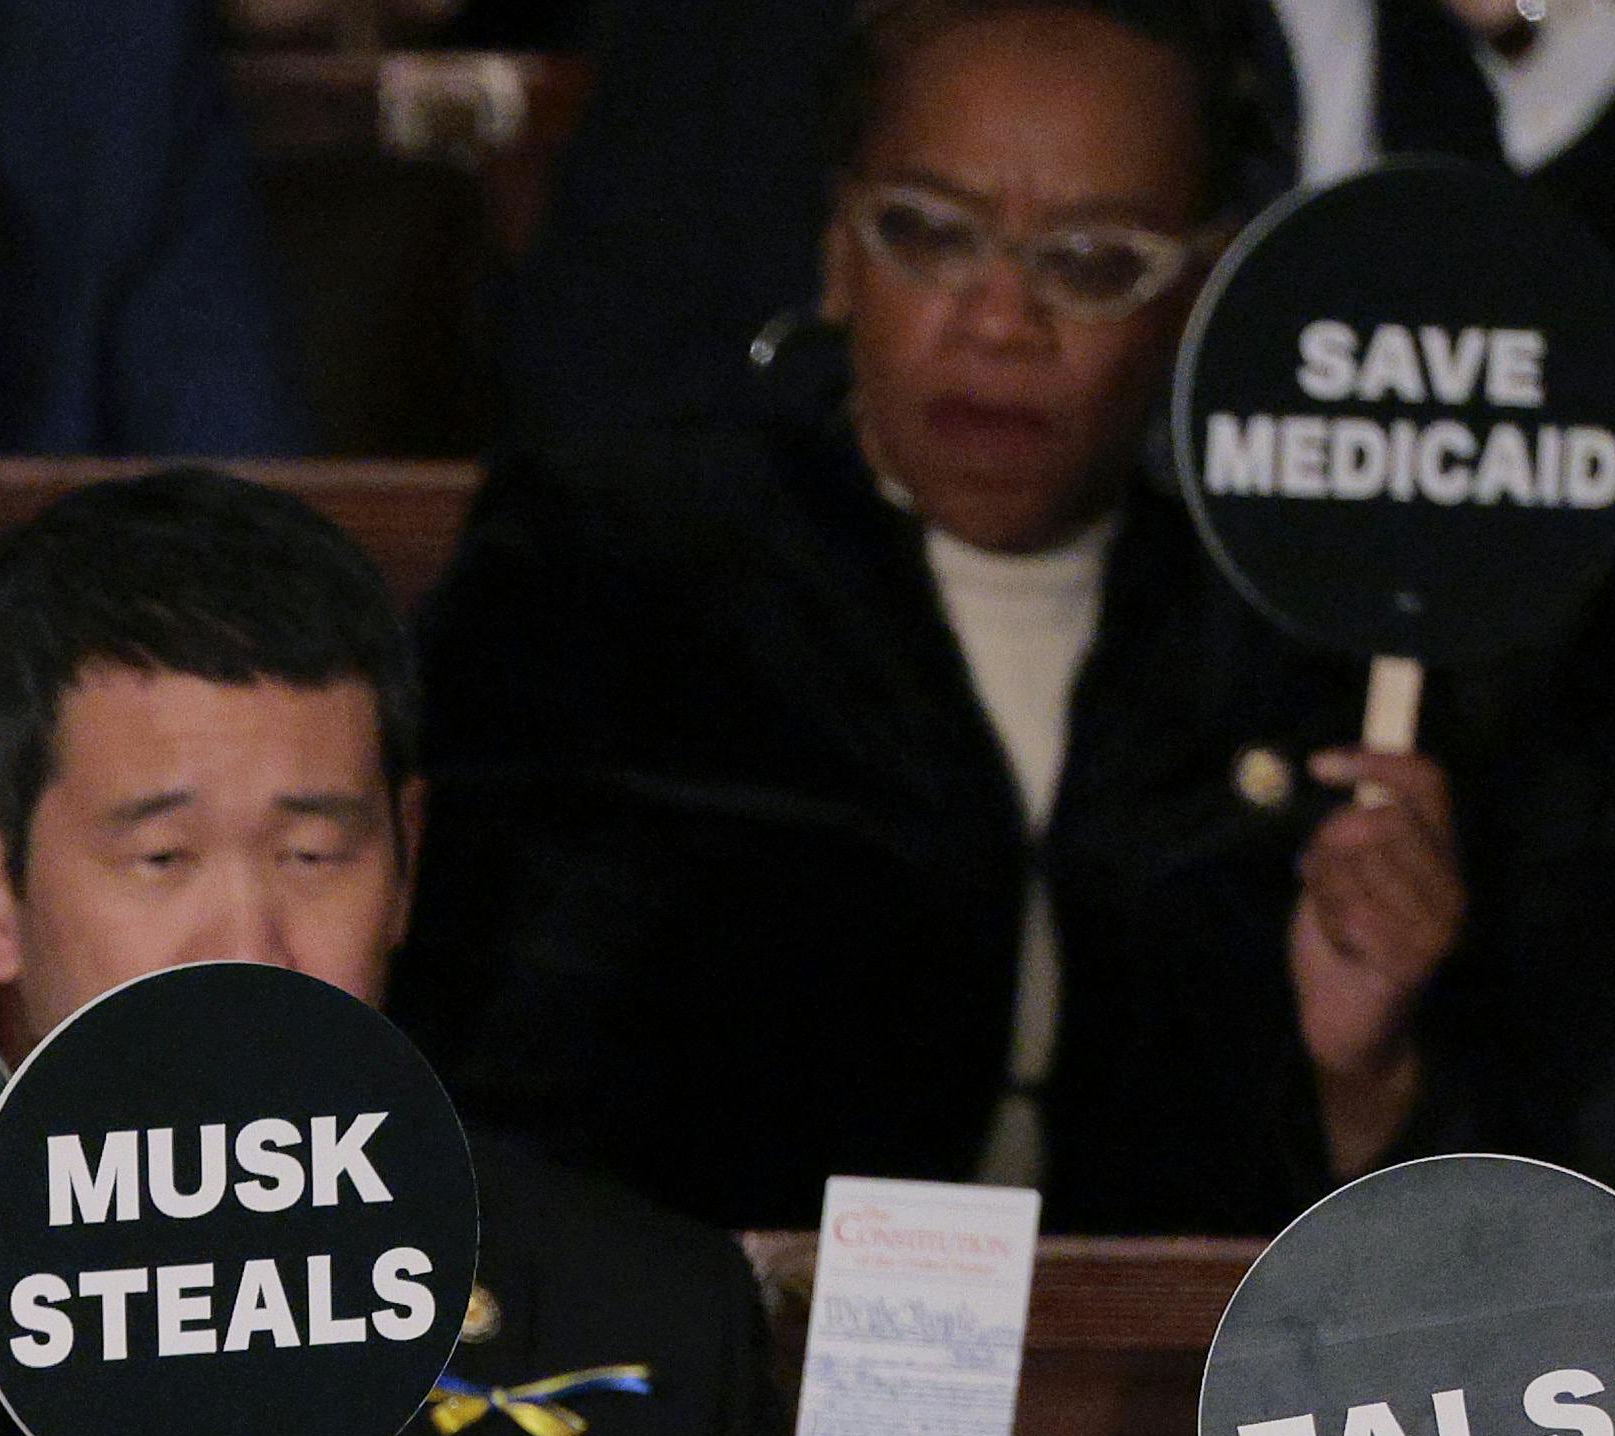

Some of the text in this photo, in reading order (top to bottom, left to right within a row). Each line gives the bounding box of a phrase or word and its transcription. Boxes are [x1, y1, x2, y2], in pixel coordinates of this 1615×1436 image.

[1296, 318, 1546, 408] SAVE
[45, 1110, 395, 1228] MUSK
[8, 1245, 437, 1370] STEALS
